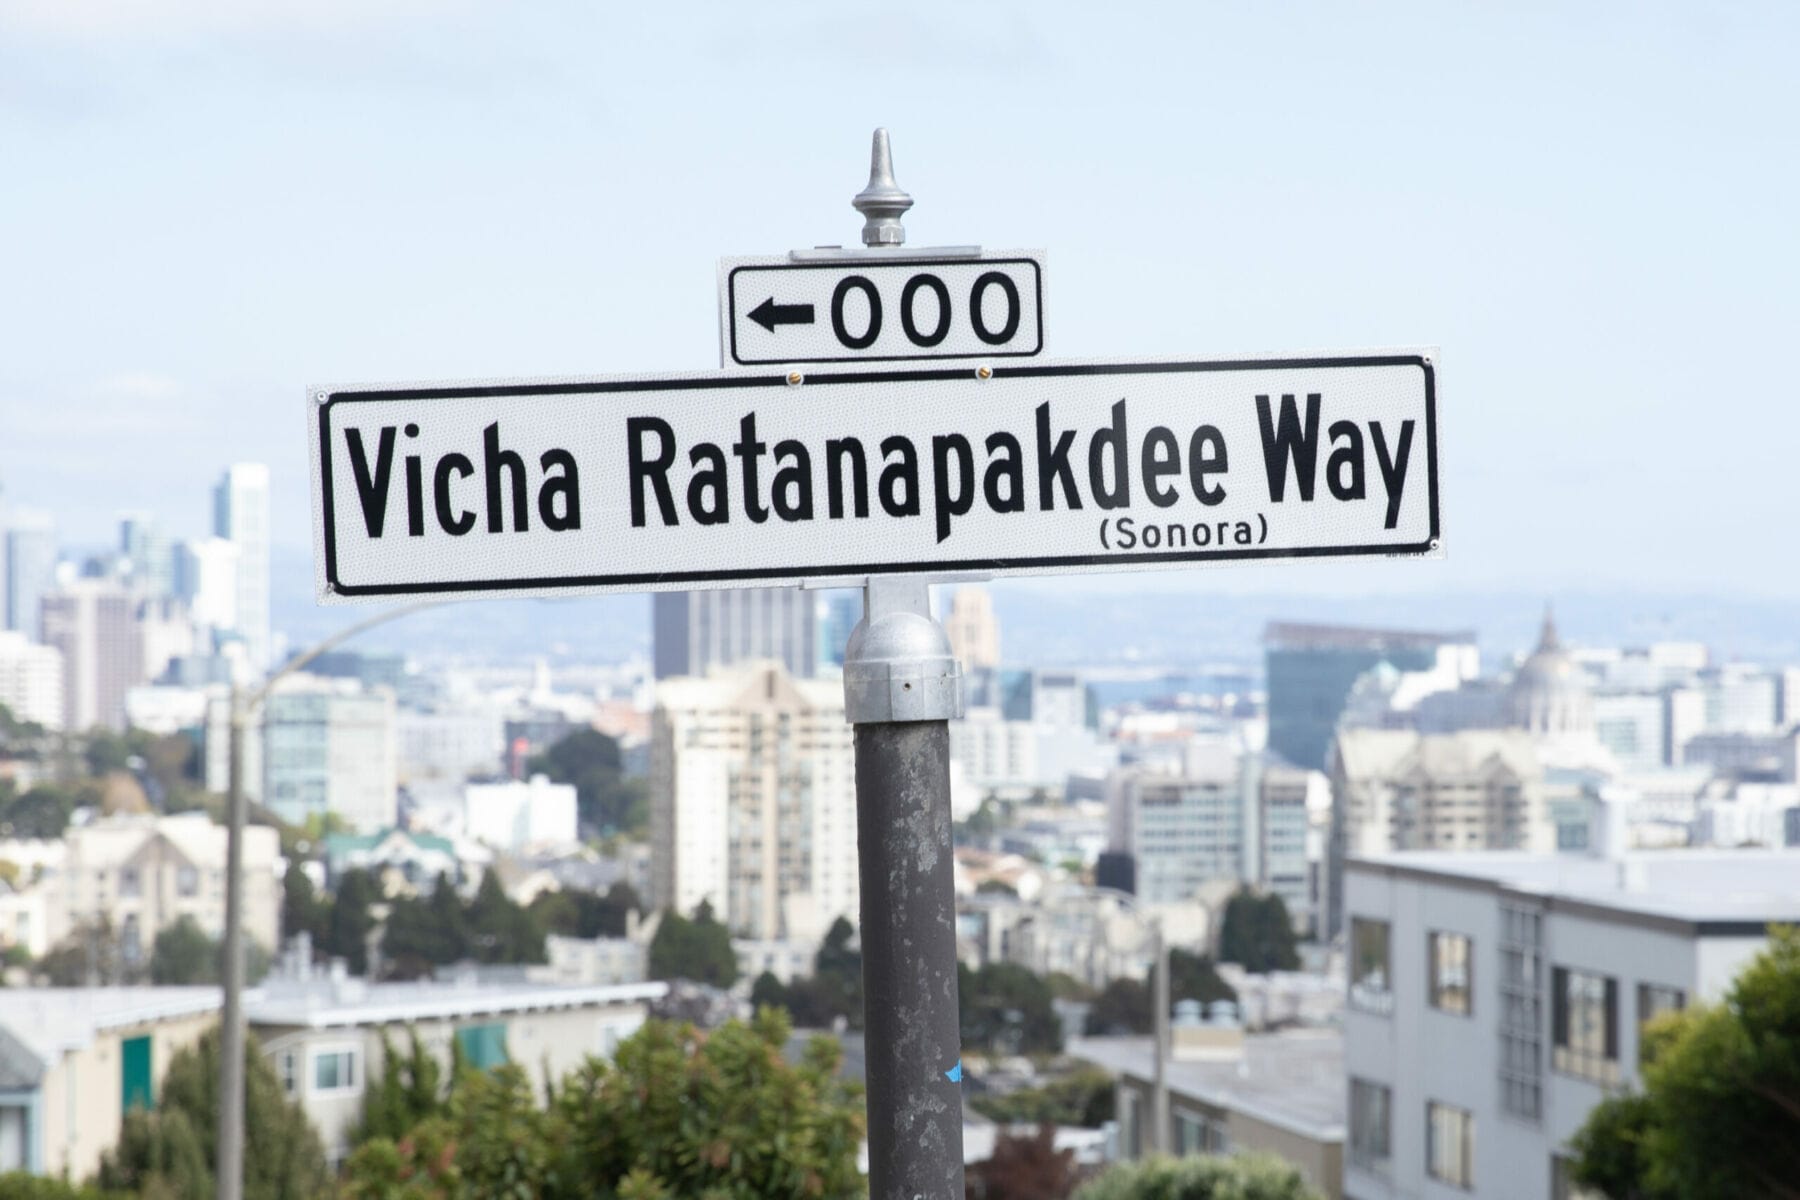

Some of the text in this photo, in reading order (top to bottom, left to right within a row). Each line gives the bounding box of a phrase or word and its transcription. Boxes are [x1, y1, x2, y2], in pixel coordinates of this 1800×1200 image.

[830, 271, 1021, 350] 000
[344, 393, 1416, 545] Vicha Ratanapakdee Way
[1099, 513, 1268, 550] (Sonora)
